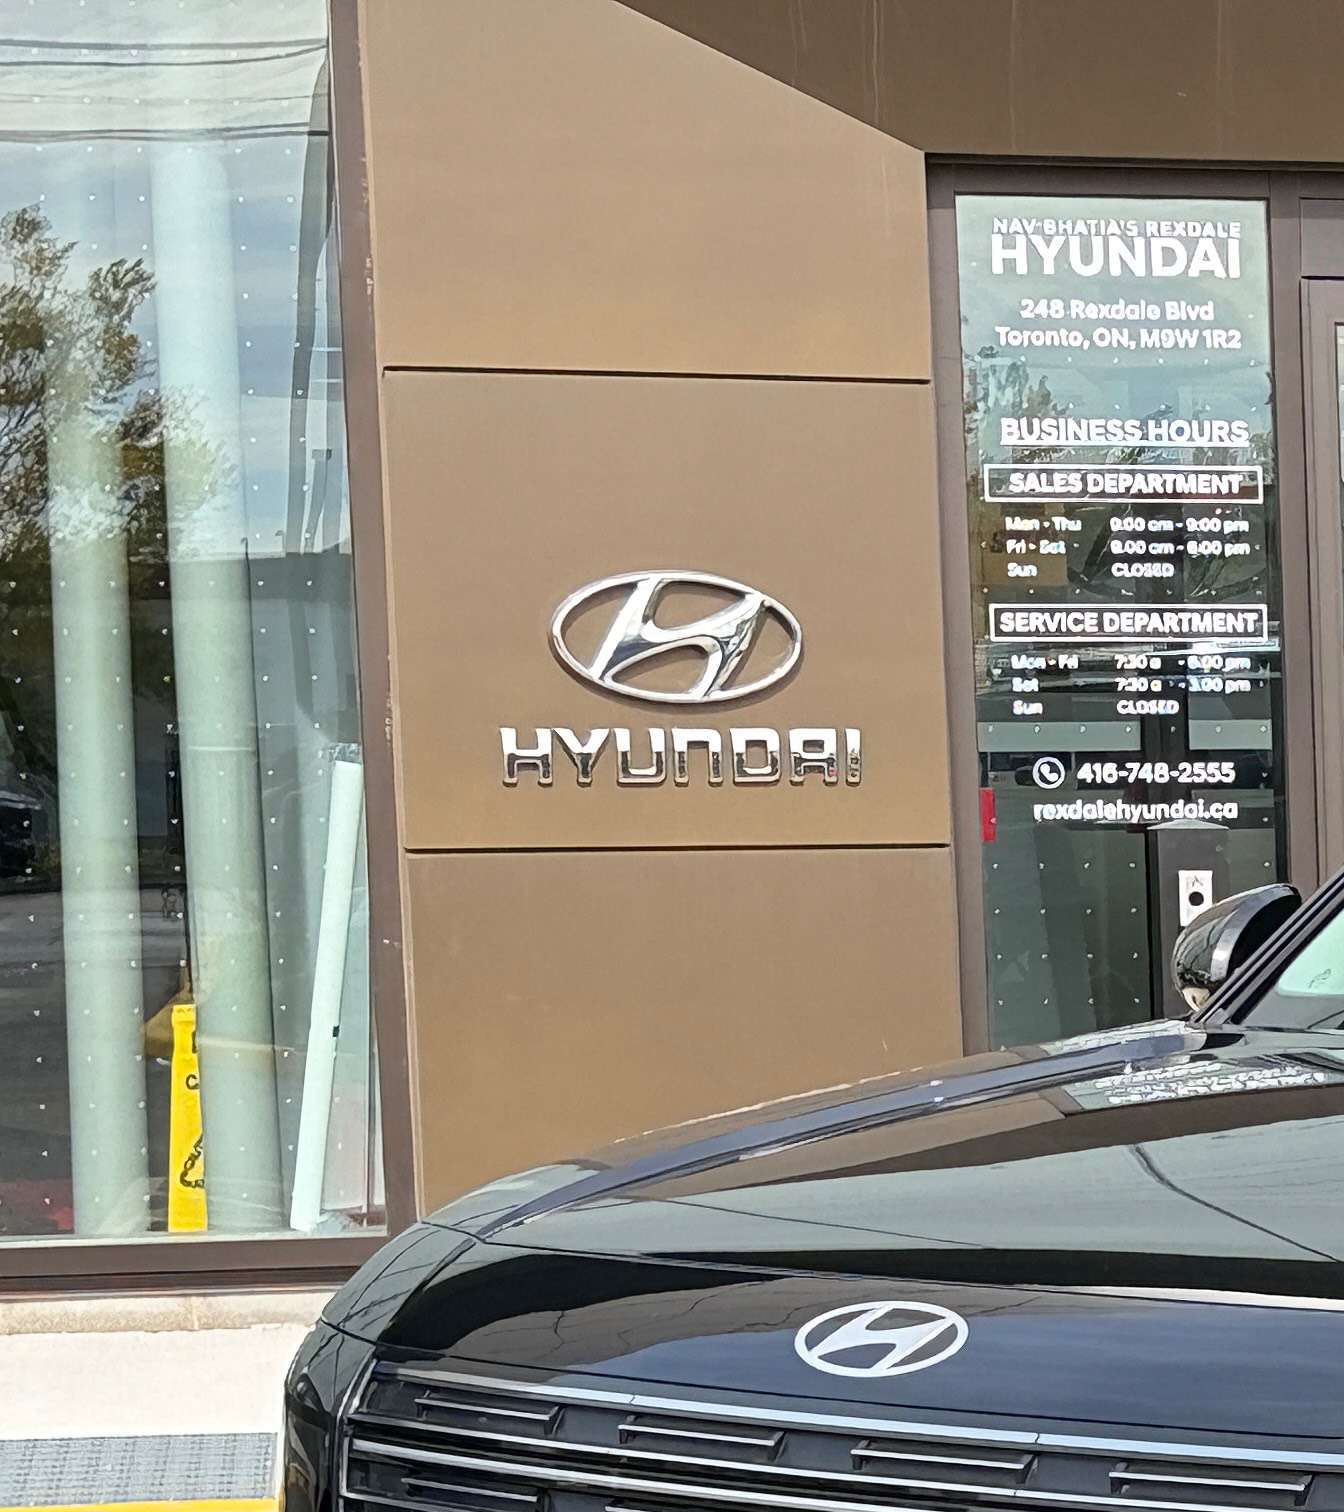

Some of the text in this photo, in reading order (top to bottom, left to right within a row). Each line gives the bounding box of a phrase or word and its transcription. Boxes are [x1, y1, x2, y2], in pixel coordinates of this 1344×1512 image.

[1146, 220, 1241, 238] REXDALE
[991, 233, 1241, 279] HYUNDAI
[1020, 298, 1214, 321] 248 Rexdale Blvd
[994, 326, 1242, 350] Toronto, ON, M9W 1R2
[1000, 417, 1249, 443] BUSINESS HOURS
[1008, 472, 1245, 495] SALES DEPARTMENT
[1111, 562, 1175, 578] CLOSED
[999, 612, 1259, 633] SERVICE DEPARTMENT
[1116, 700, 1180, 714] CLOSED
[499, 726, 863, 788] HYUNDAI
[1076, 762, 1236, 784] 416-748-2555
[1033, 798, 1239, 822] rexdalehyundai.ca
